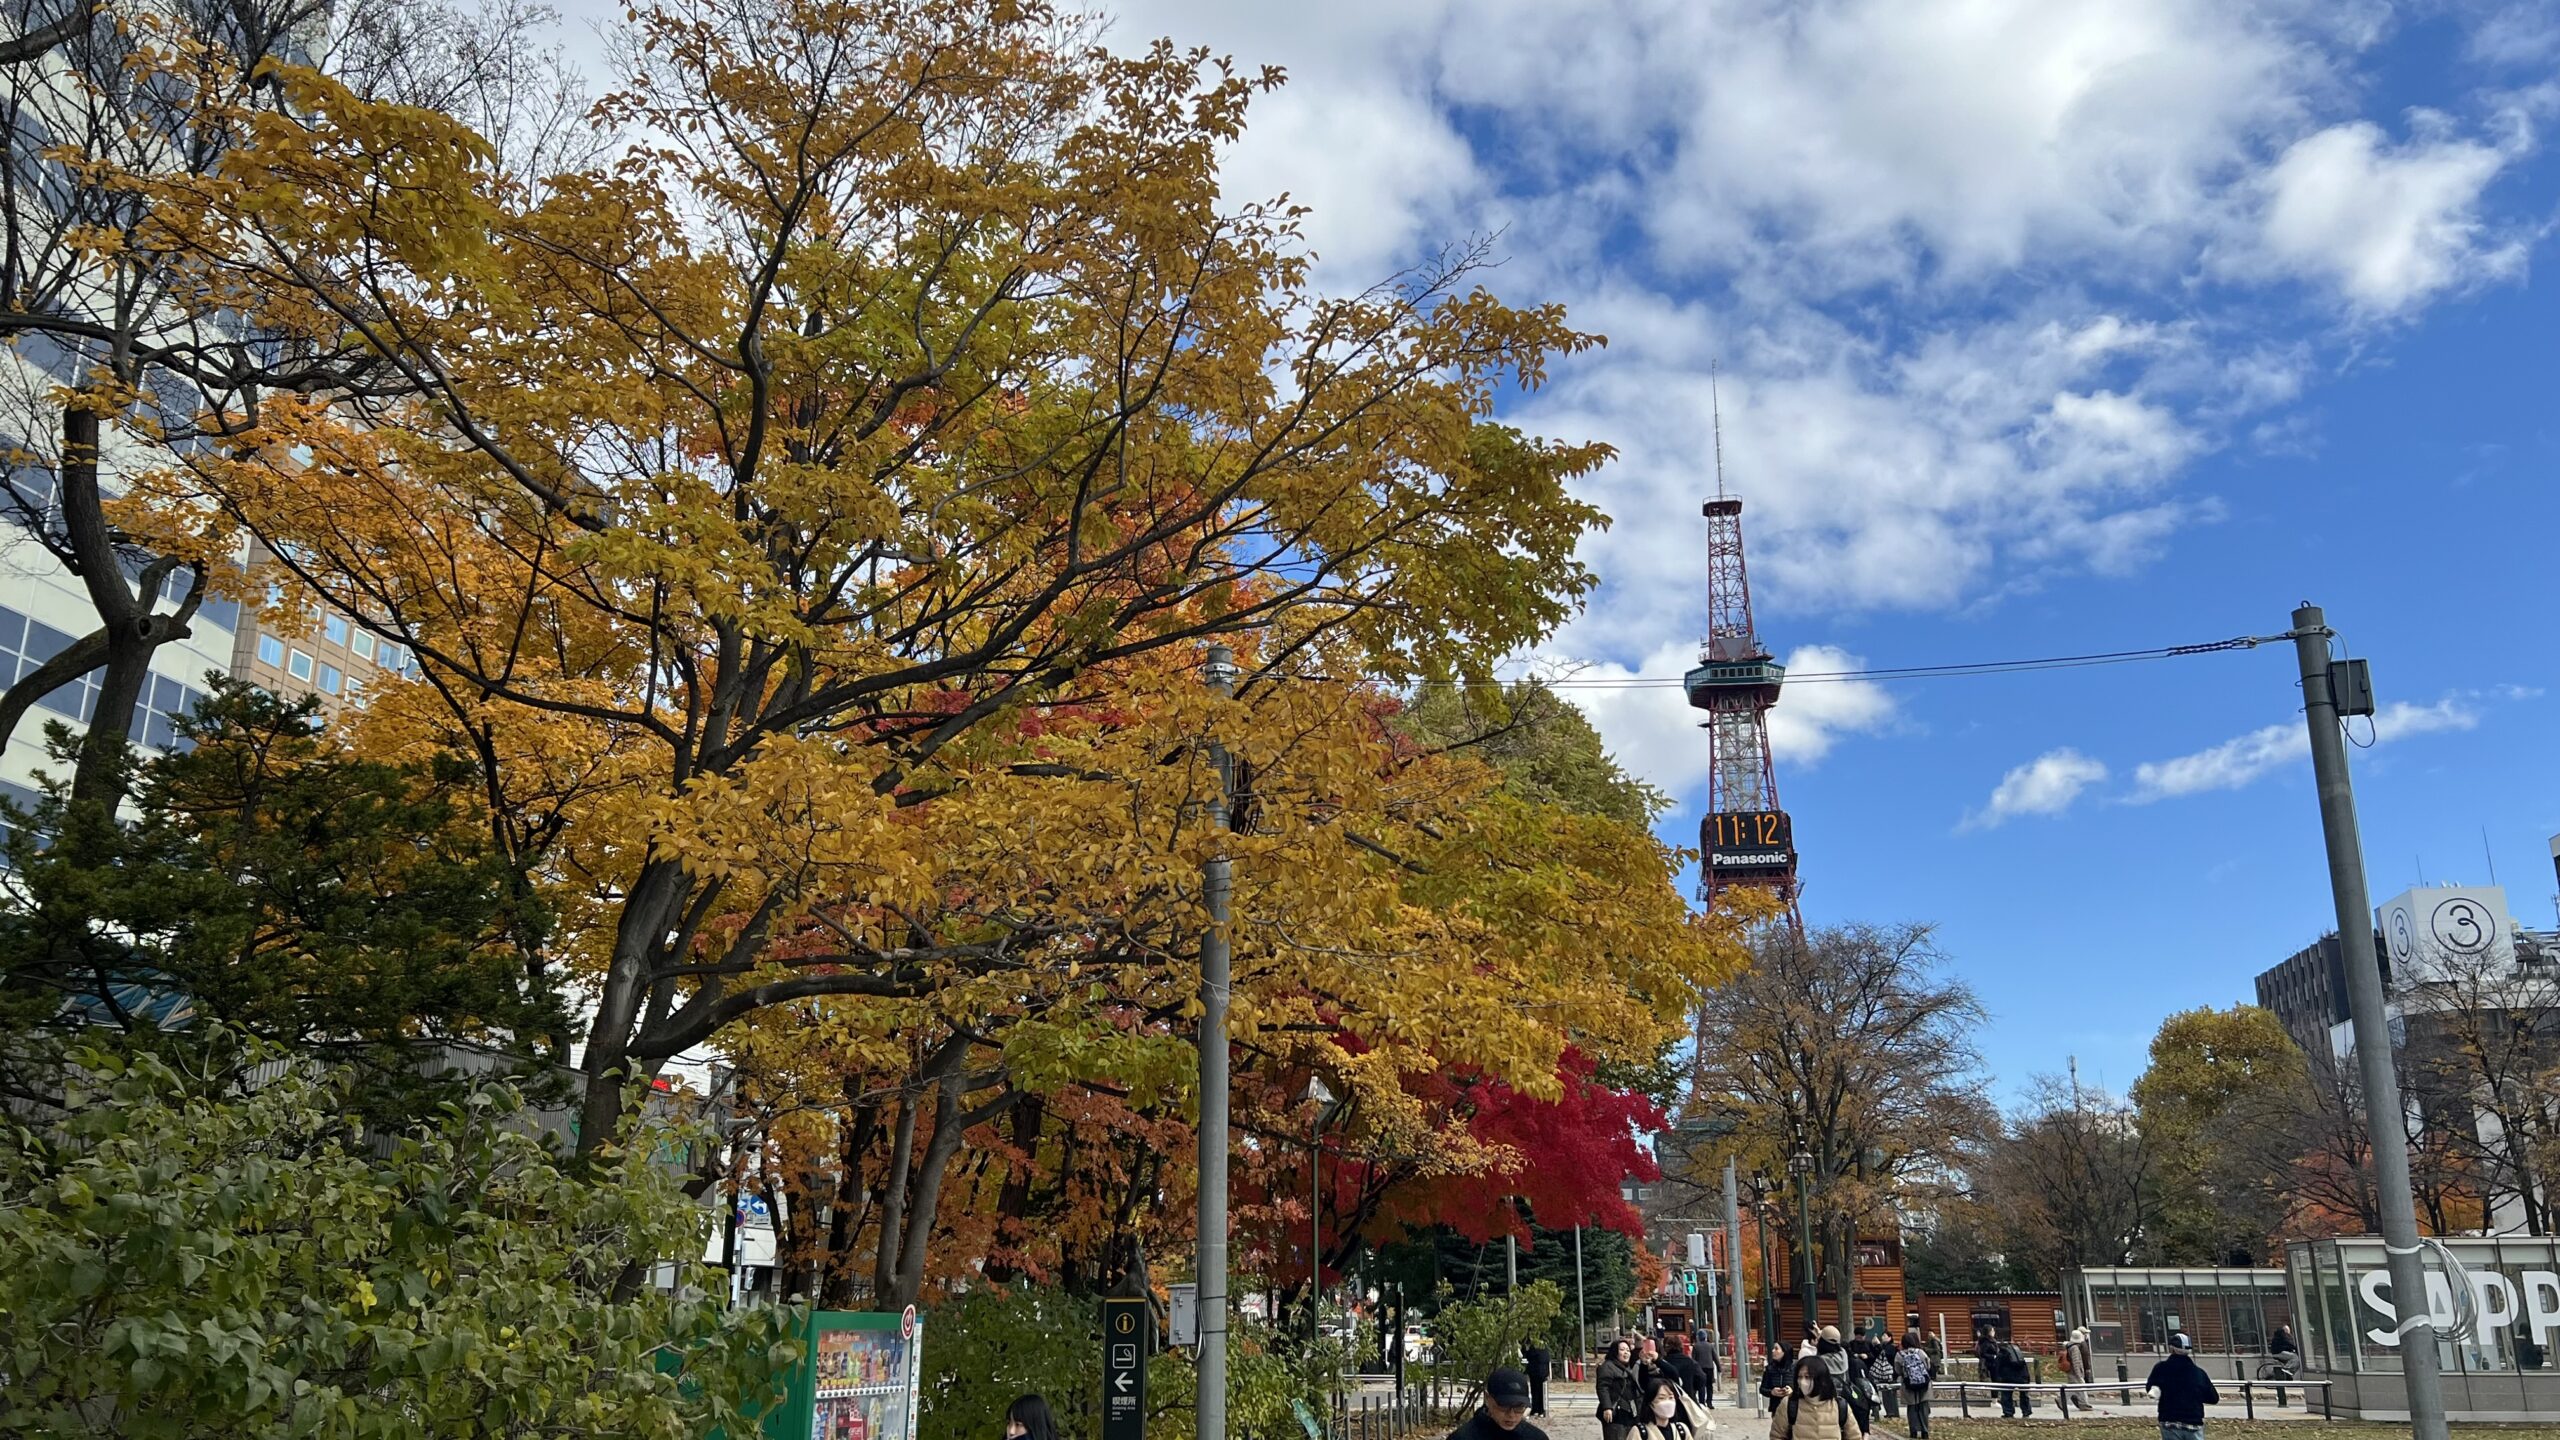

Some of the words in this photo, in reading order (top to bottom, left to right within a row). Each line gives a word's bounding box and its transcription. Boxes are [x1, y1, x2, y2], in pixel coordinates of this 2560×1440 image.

[1715, 814, 1779, 846] 11:12
[1712, 852, 1787, 865] Panasonic
[2448, 904, 2482, 947] 3
